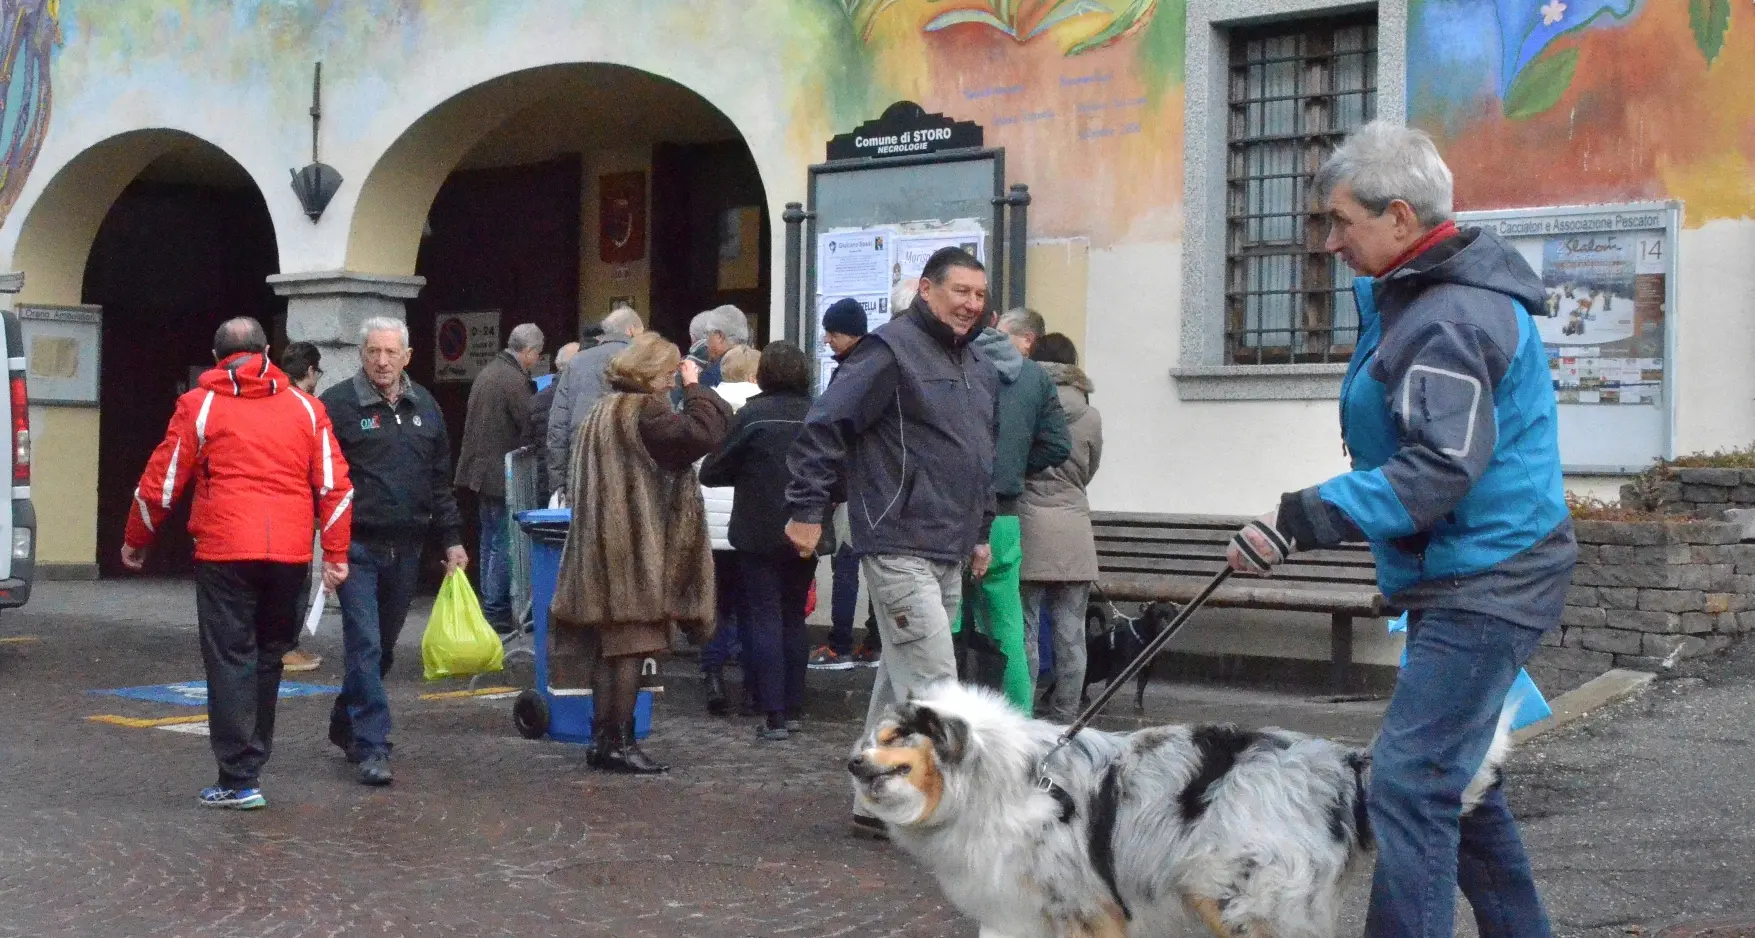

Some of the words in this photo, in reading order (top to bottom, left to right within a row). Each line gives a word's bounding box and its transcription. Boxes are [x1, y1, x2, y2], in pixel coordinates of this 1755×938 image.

[855, 136, 898, 148] Comune
[901, 132, 911, 143] di
[913, 128, 952, 141] STORO
[877, 142, 928, 154] NECROLOGIE
[1500, 221, 1543, 234] Cacciatori
[1545, 222, 1551, 232] e
[1553, 218, 1612, 231] Associazione
[1615, 214, 1660, 228] Pescatori
[1641, 240, 1662, 260] 14
